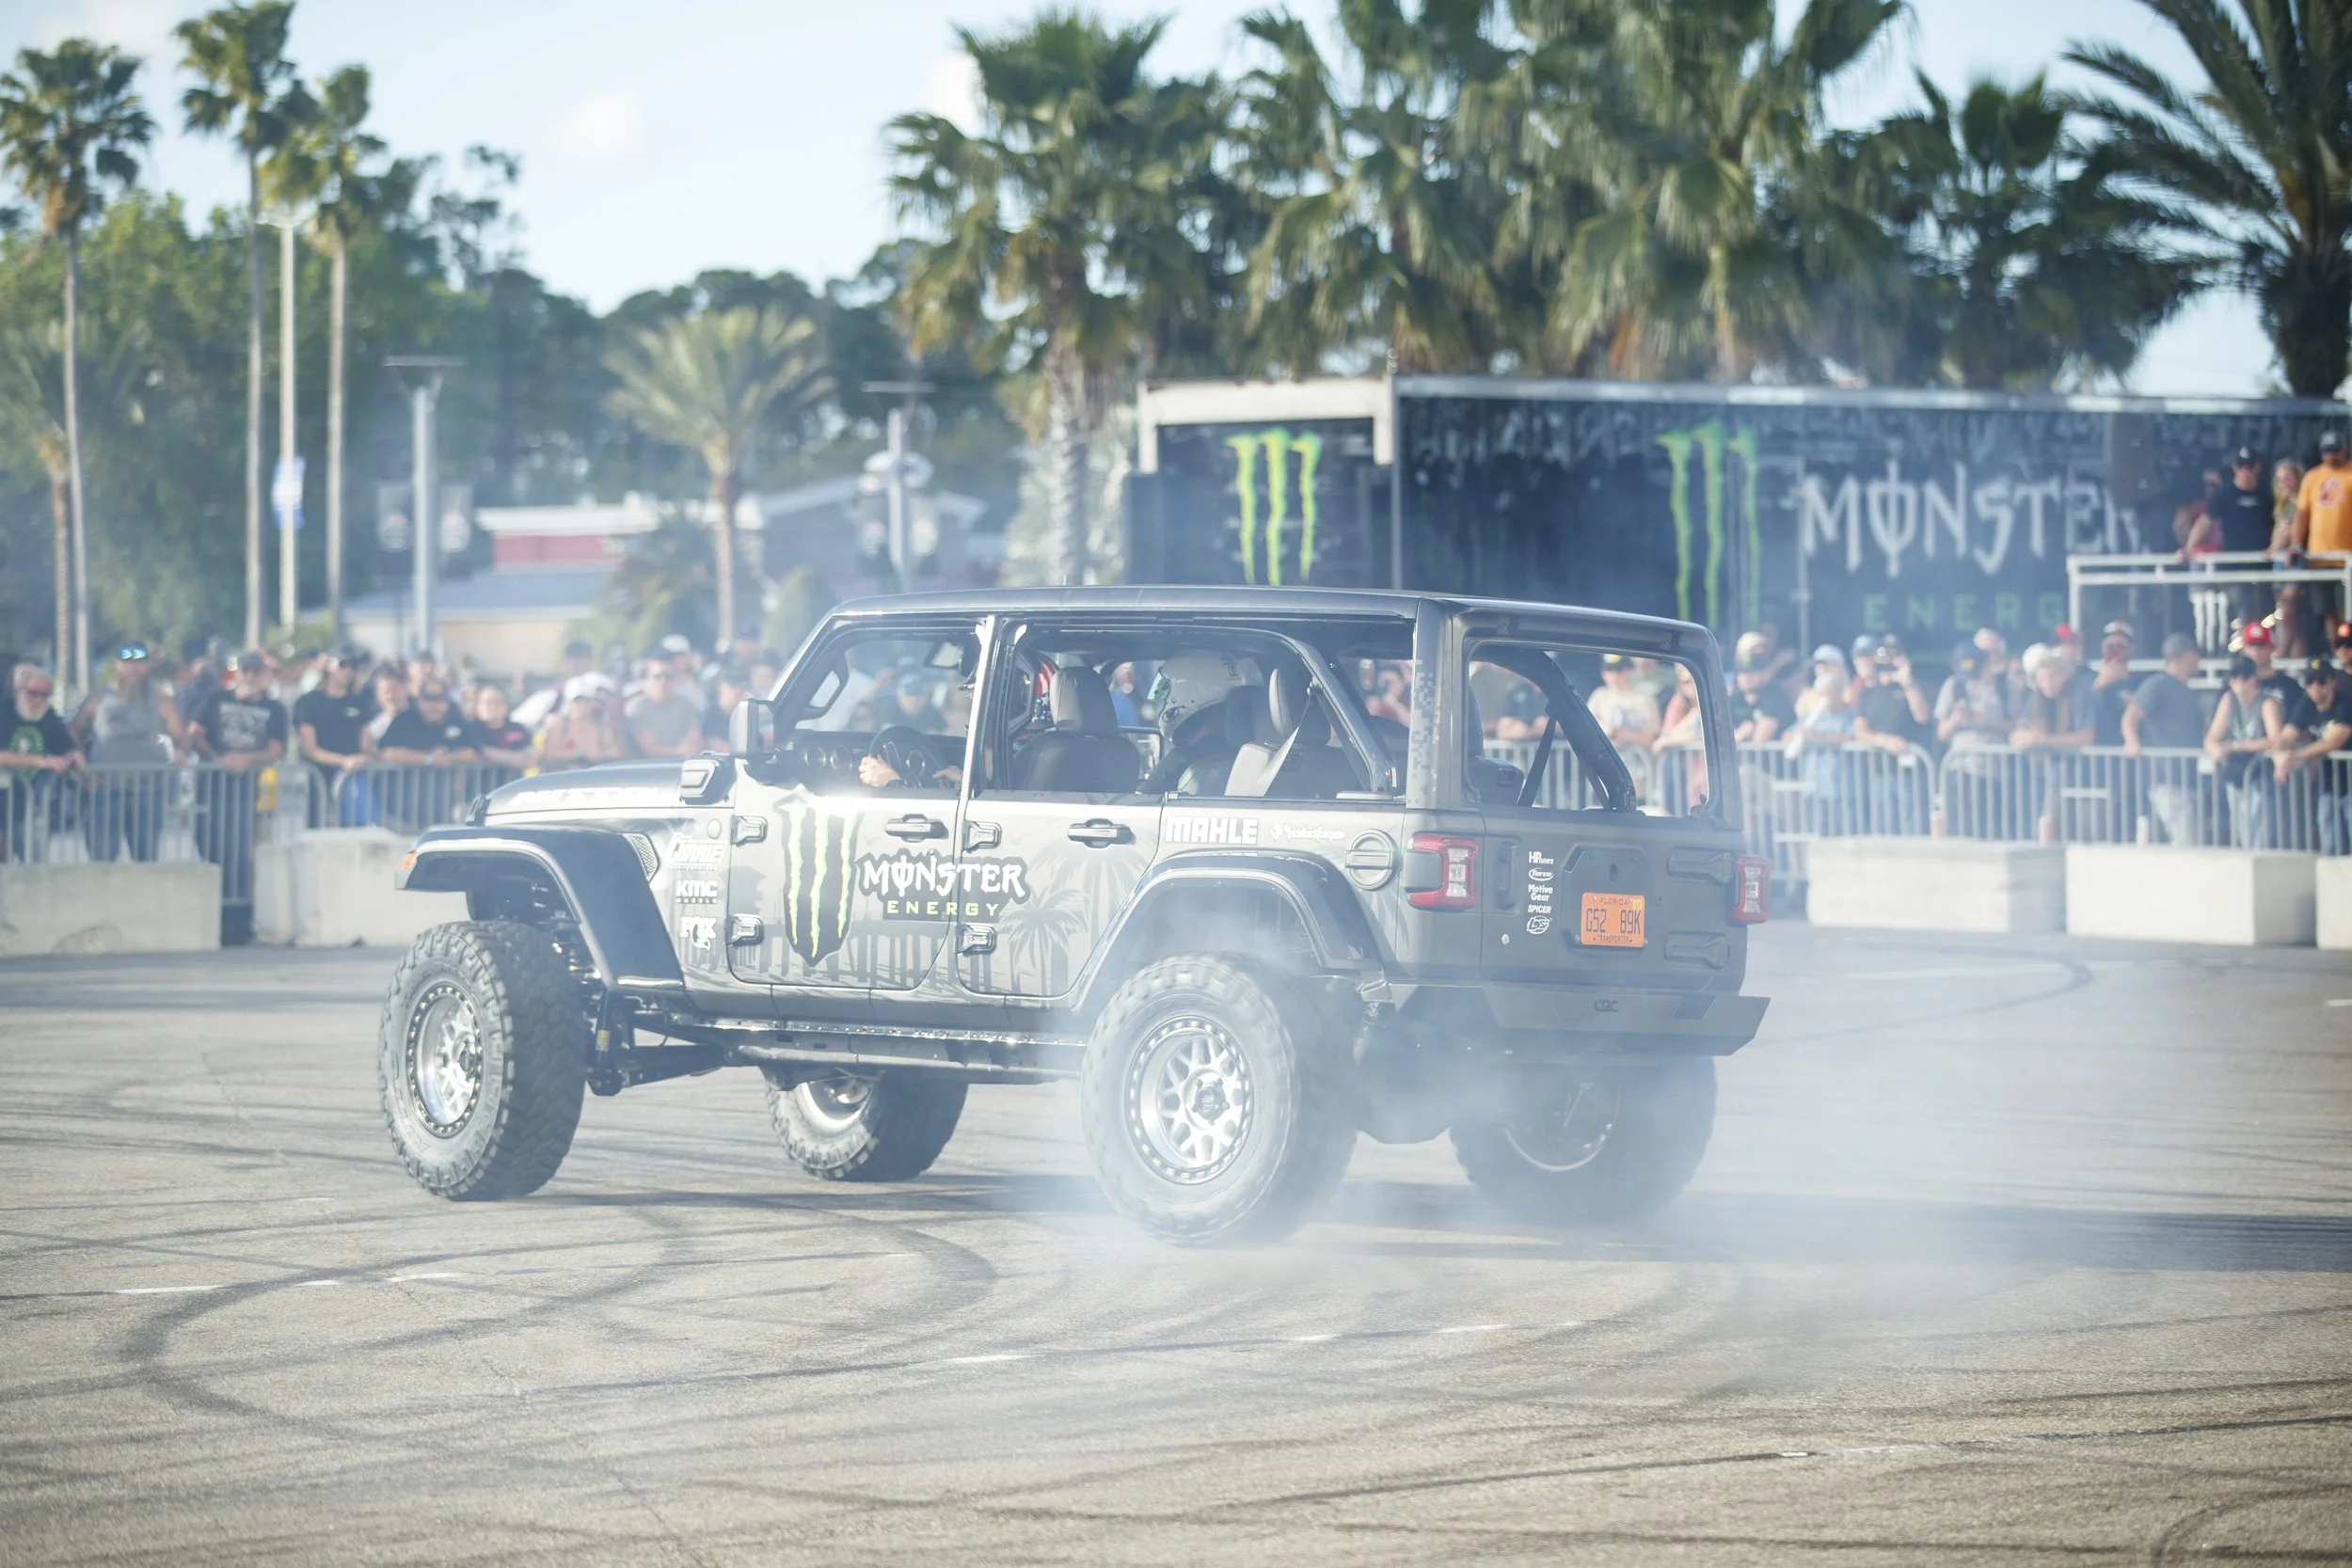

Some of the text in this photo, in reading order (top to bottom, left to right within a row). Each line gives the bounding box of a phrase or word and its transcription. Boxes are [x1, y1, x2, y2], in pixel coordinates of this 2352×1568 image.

[1165, 817, 1259, 845] MAHLE
[863, 855, 1025, 897] MONSTER
[676, 879, 717, 897] KMC
[1528, 884, 1553, 894] Motive
[1531, 893, 1550, 901] Gear
[1599, 897, 1629, 906] FLORIDA
[887, 900, 999, 917] ENERGY
[1528, 904, 1552, 914] SPICER
[1586, 908, 1642, 934] G52 89K
[680, 916, 717, 948] FOX
